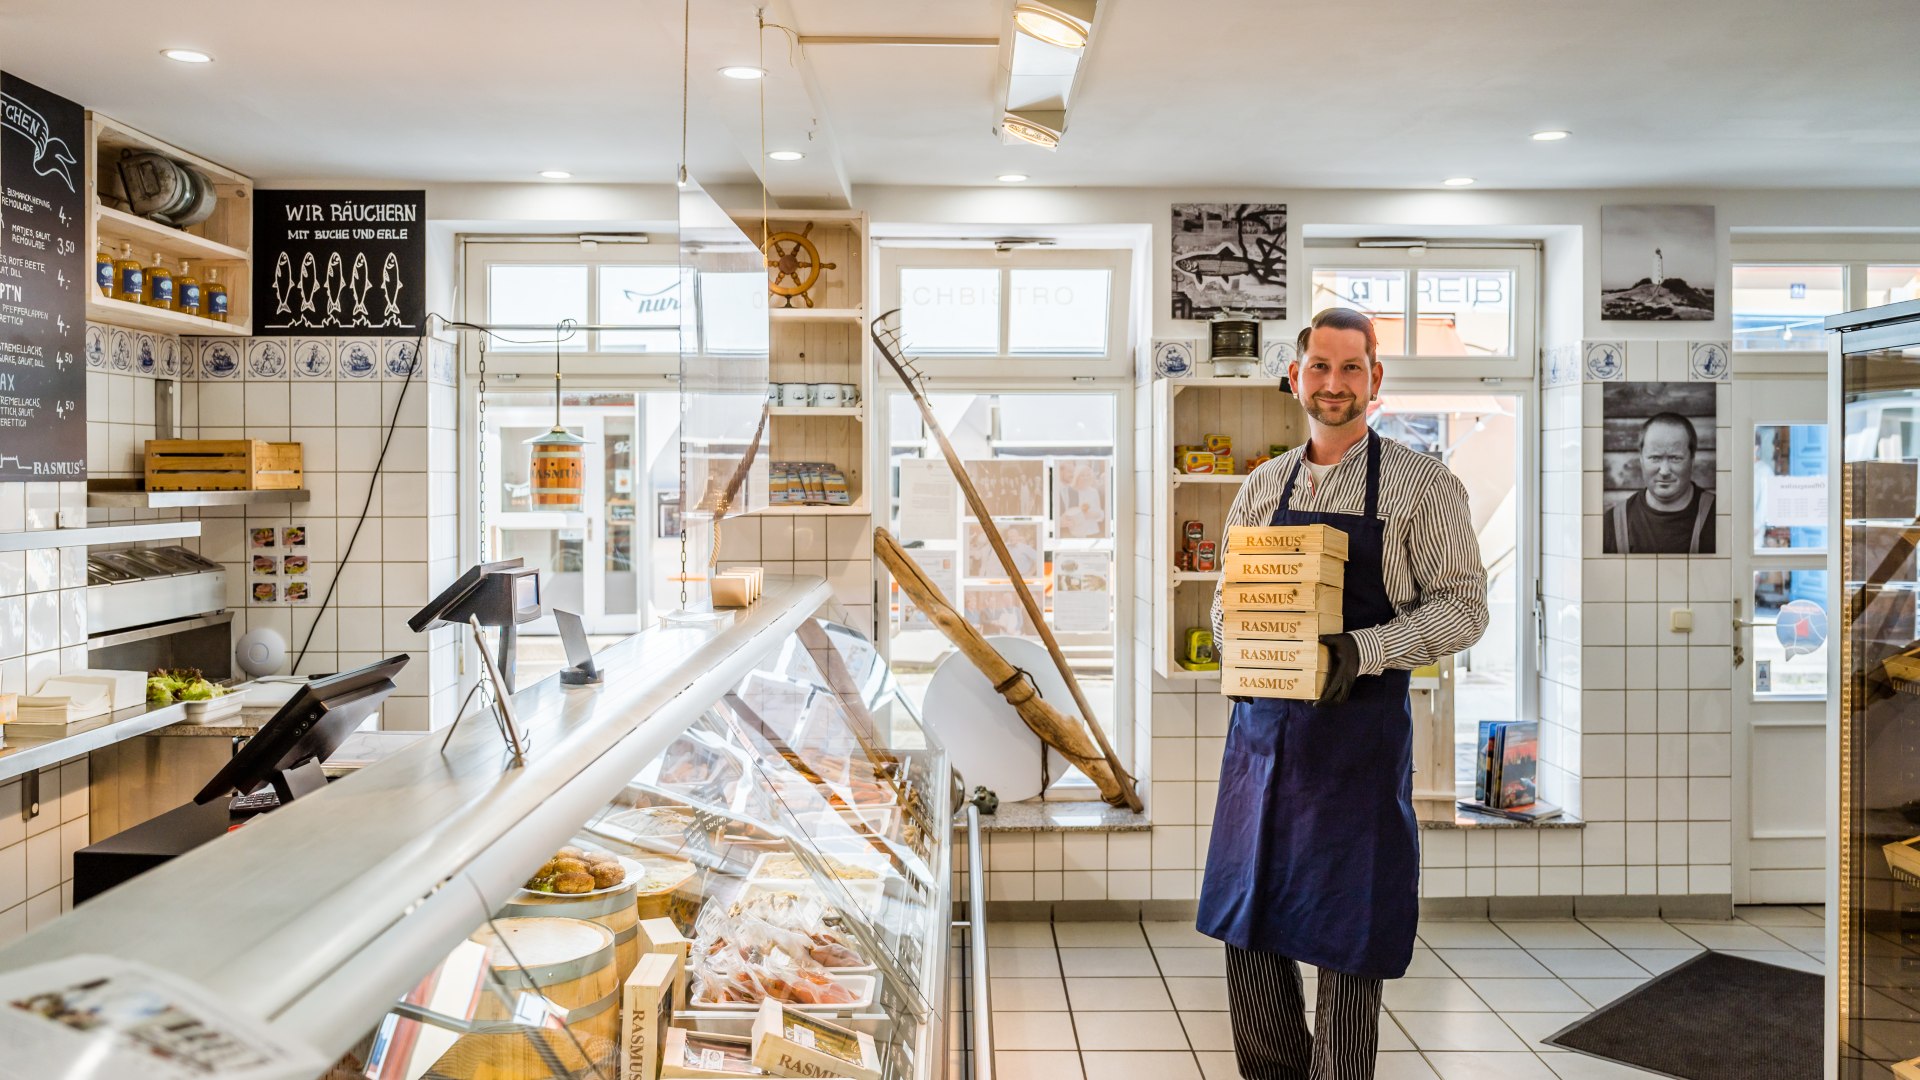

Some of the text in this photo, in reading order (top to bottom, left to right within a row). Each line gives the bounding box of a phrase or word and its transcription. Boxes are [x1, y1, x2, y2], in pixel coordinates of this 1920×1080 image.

[2, 196, 34, 213] REMOULADE
[285, 200, 417, 221] WIR RÄUCHERN
[12, 224, 35, 239] MATJES,
[287, 228, 408, 240] MIT BUCHE UND ERLE
[11, 233, 46, 250] REMOULADE
[8, 256, 24, 267] ROTE
[24, 259, 46, 275] BEETE,
[10, 267, 23, 278] DILL
[779, 1053, 848, 1079] RASM
